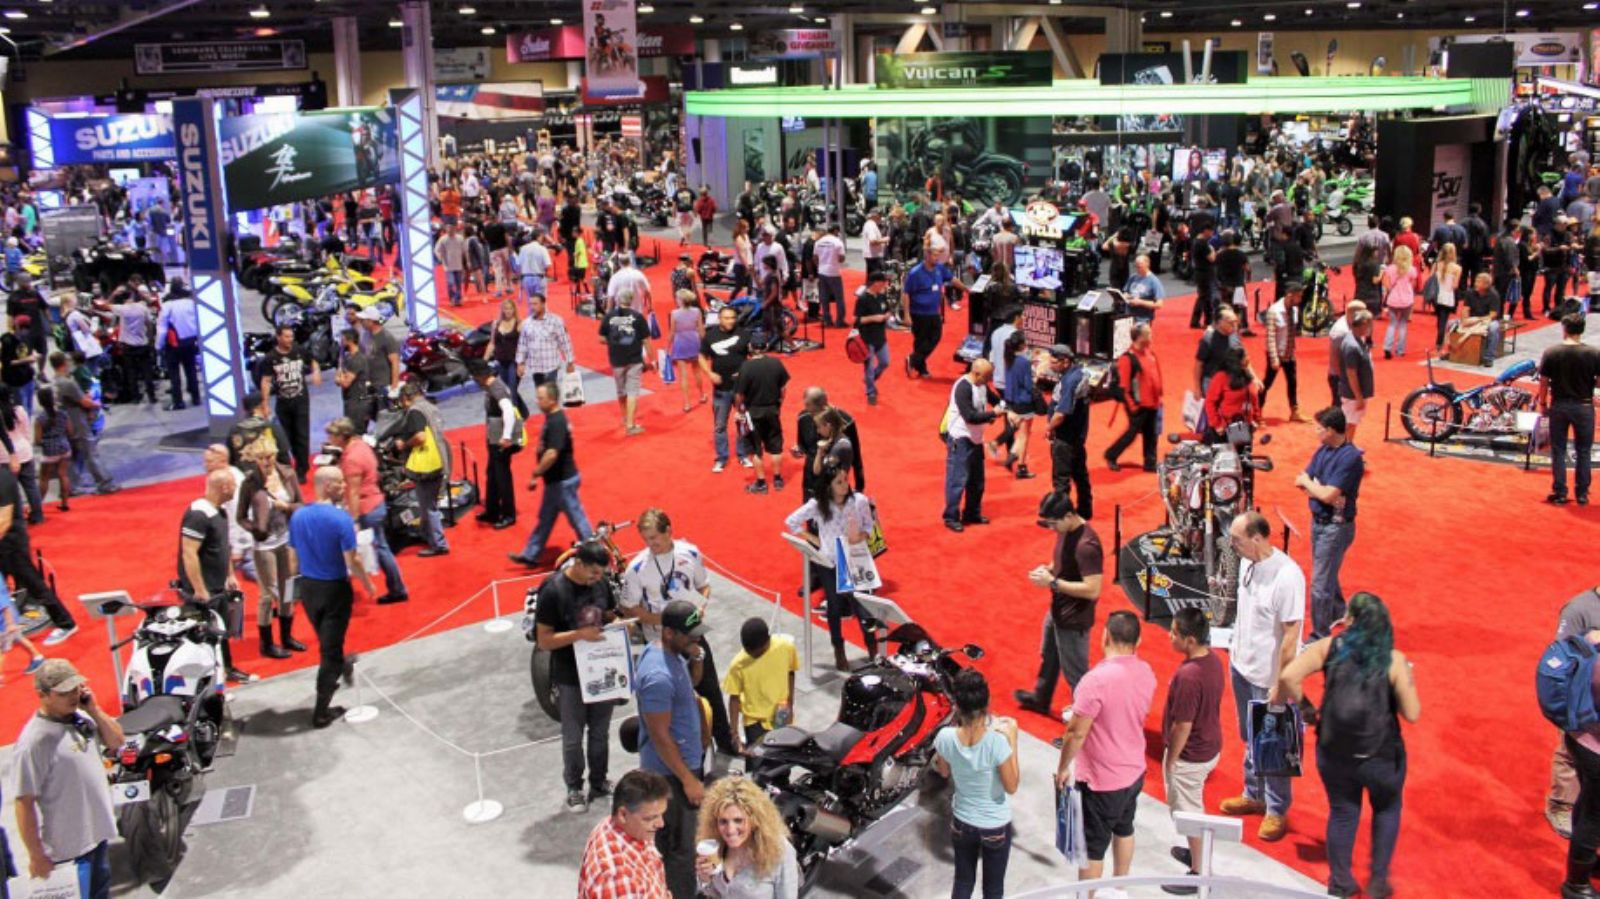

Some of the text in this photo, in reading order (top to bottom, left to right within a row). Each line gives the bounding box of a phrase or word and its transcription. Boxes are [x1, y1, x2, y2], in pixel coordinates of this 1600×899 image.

[904, 65, 1013, 80] Vulcan S
[75, 114, 175, 150] SUZUK
[180, 122, 211, 250] SUZUKI
[1023, 318, 1050, 334] EADER
